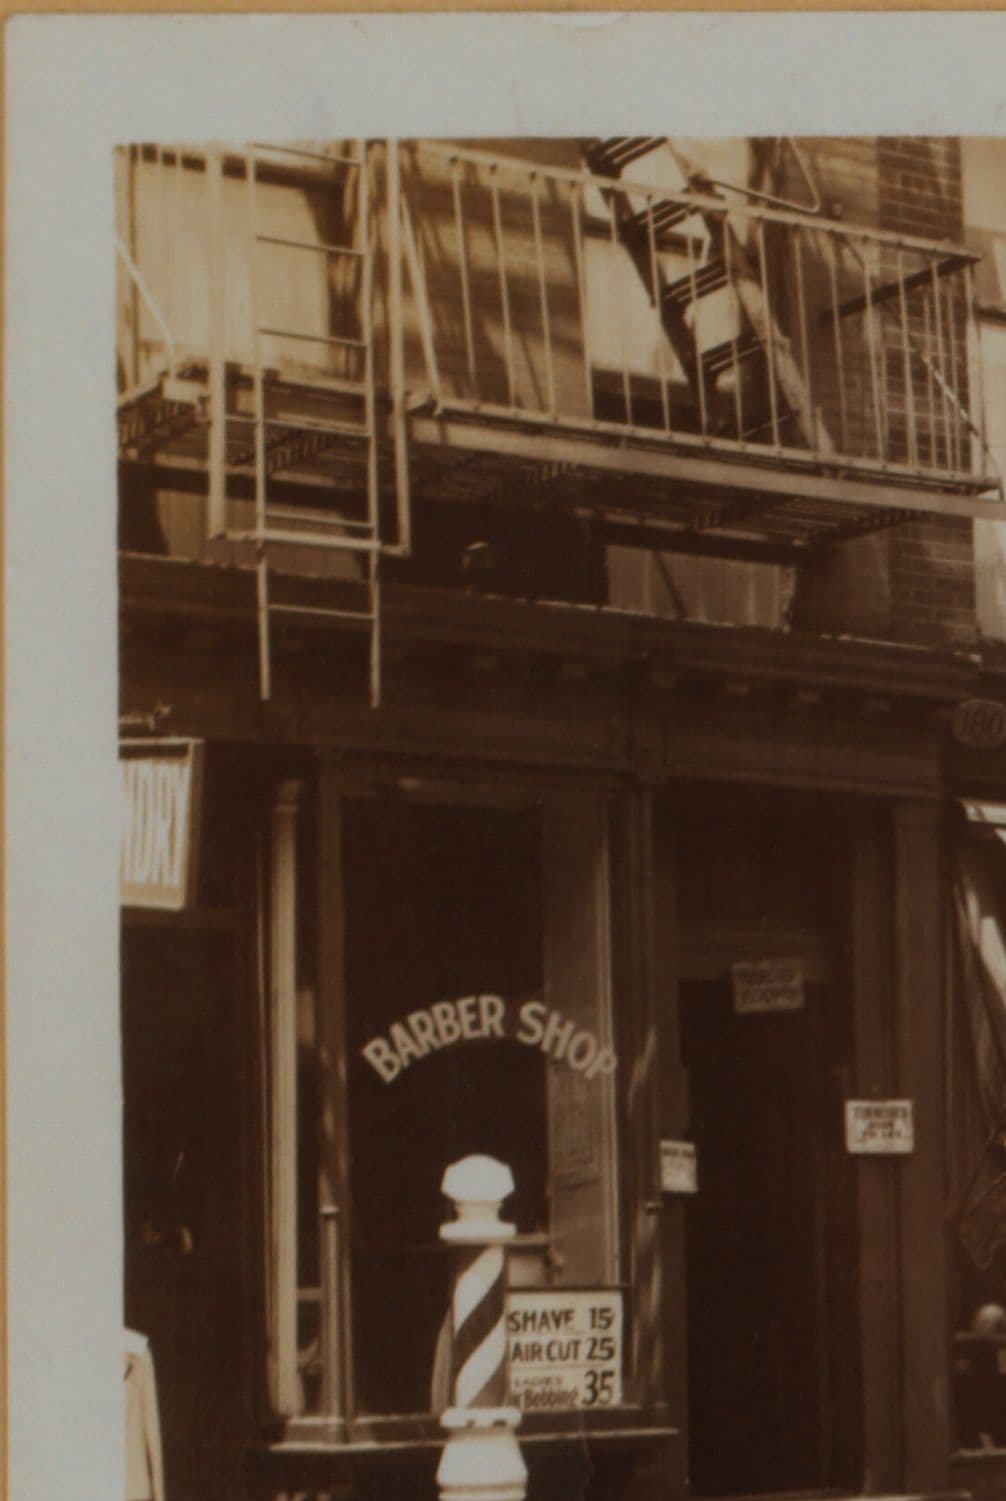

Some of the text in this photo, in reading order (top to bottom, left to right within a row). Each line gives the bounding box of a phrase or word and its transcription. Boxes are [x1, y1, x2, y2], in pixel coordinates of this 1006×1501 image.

[361, 994, 619, 1084] BARBER SHOP
[507, 1306, 616, 1333] SHAVE 15
[511, 1341, 543, 1362] AIR
[585, 1336, 617, 1361] 25
[581, 1369, 616, 1408] 35
